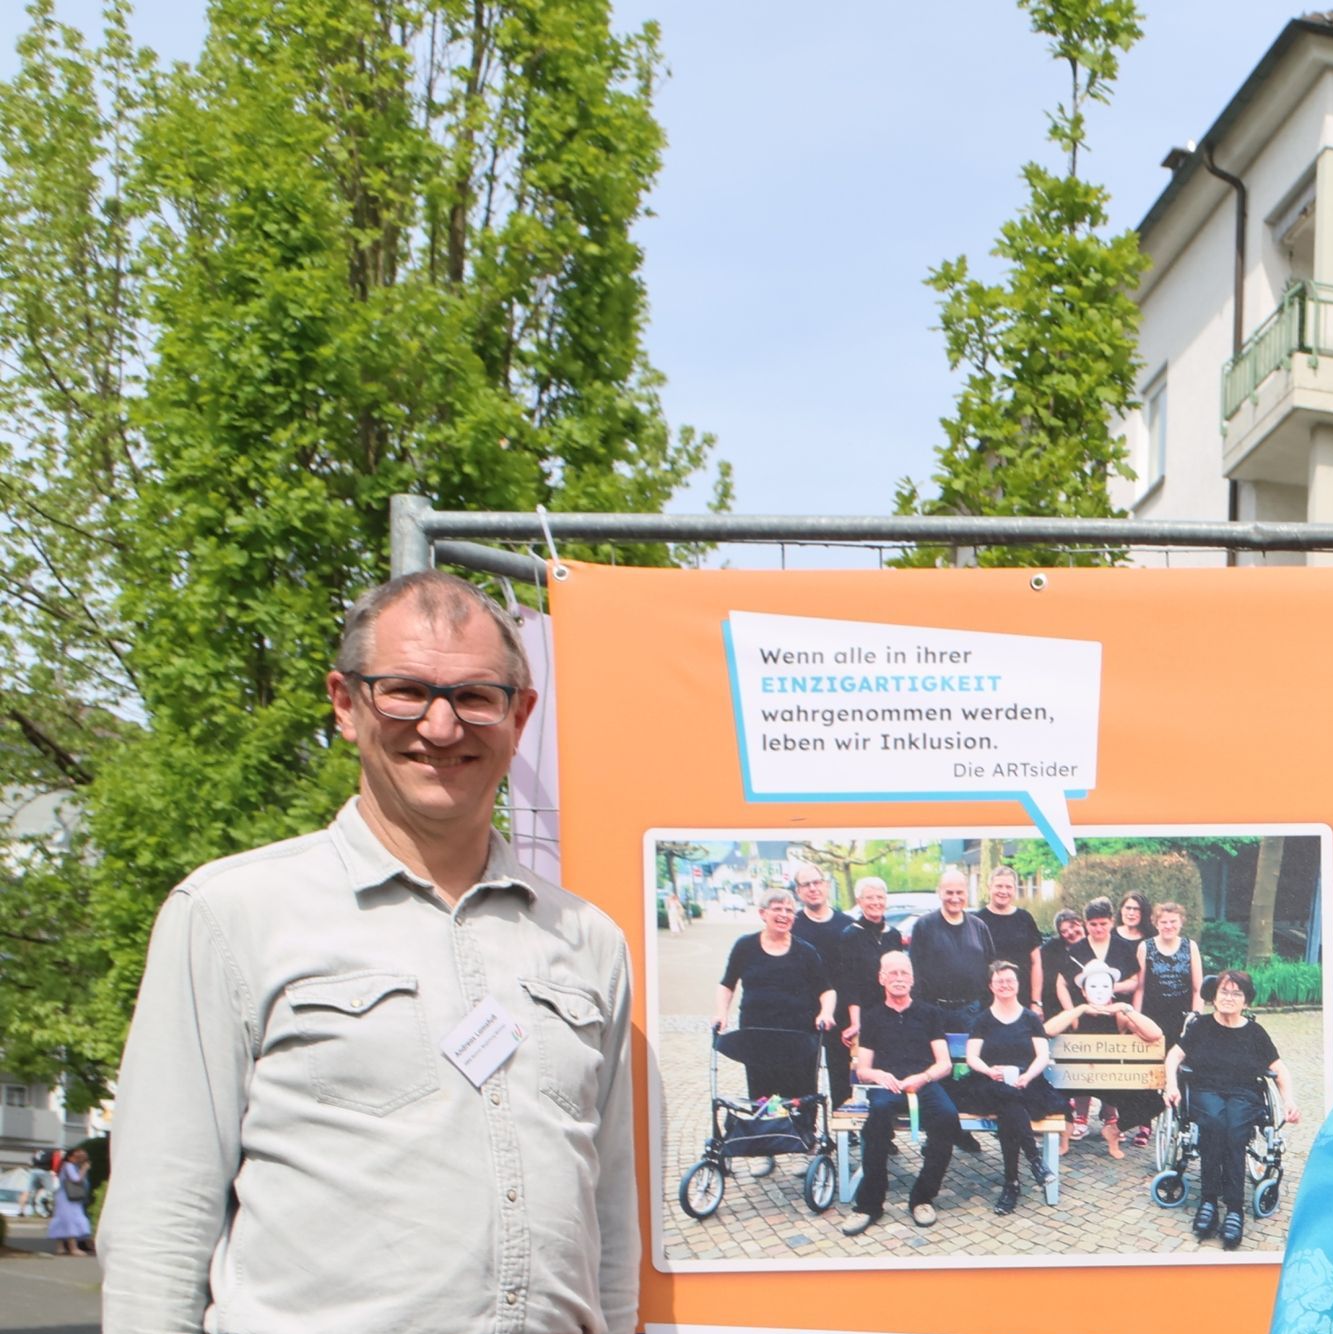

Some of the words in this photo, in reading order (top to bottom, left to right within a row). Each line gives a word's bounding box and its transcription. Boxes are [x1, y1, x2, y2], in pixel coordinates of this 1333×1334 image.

[759, 648, 824, 664] Wenn
[834, 647, 876, 664] alle
[886, 646, 906, 664] in
[917, 646, 972, 664] ihrer
[761, 675, 1001, 693] EINZIGARTIGKEIT
[761, 705, 952, 727] wahrgenommen
[961, 703, 1054, 723] werden,
[762, 734, 825, 751] leben
[835, 732, 871, 750] wir
[881, 731, 998, 750] Inklusion.
[954, 762, 985, 778] Die
[992, 761, 1078, 777] ARTsider
